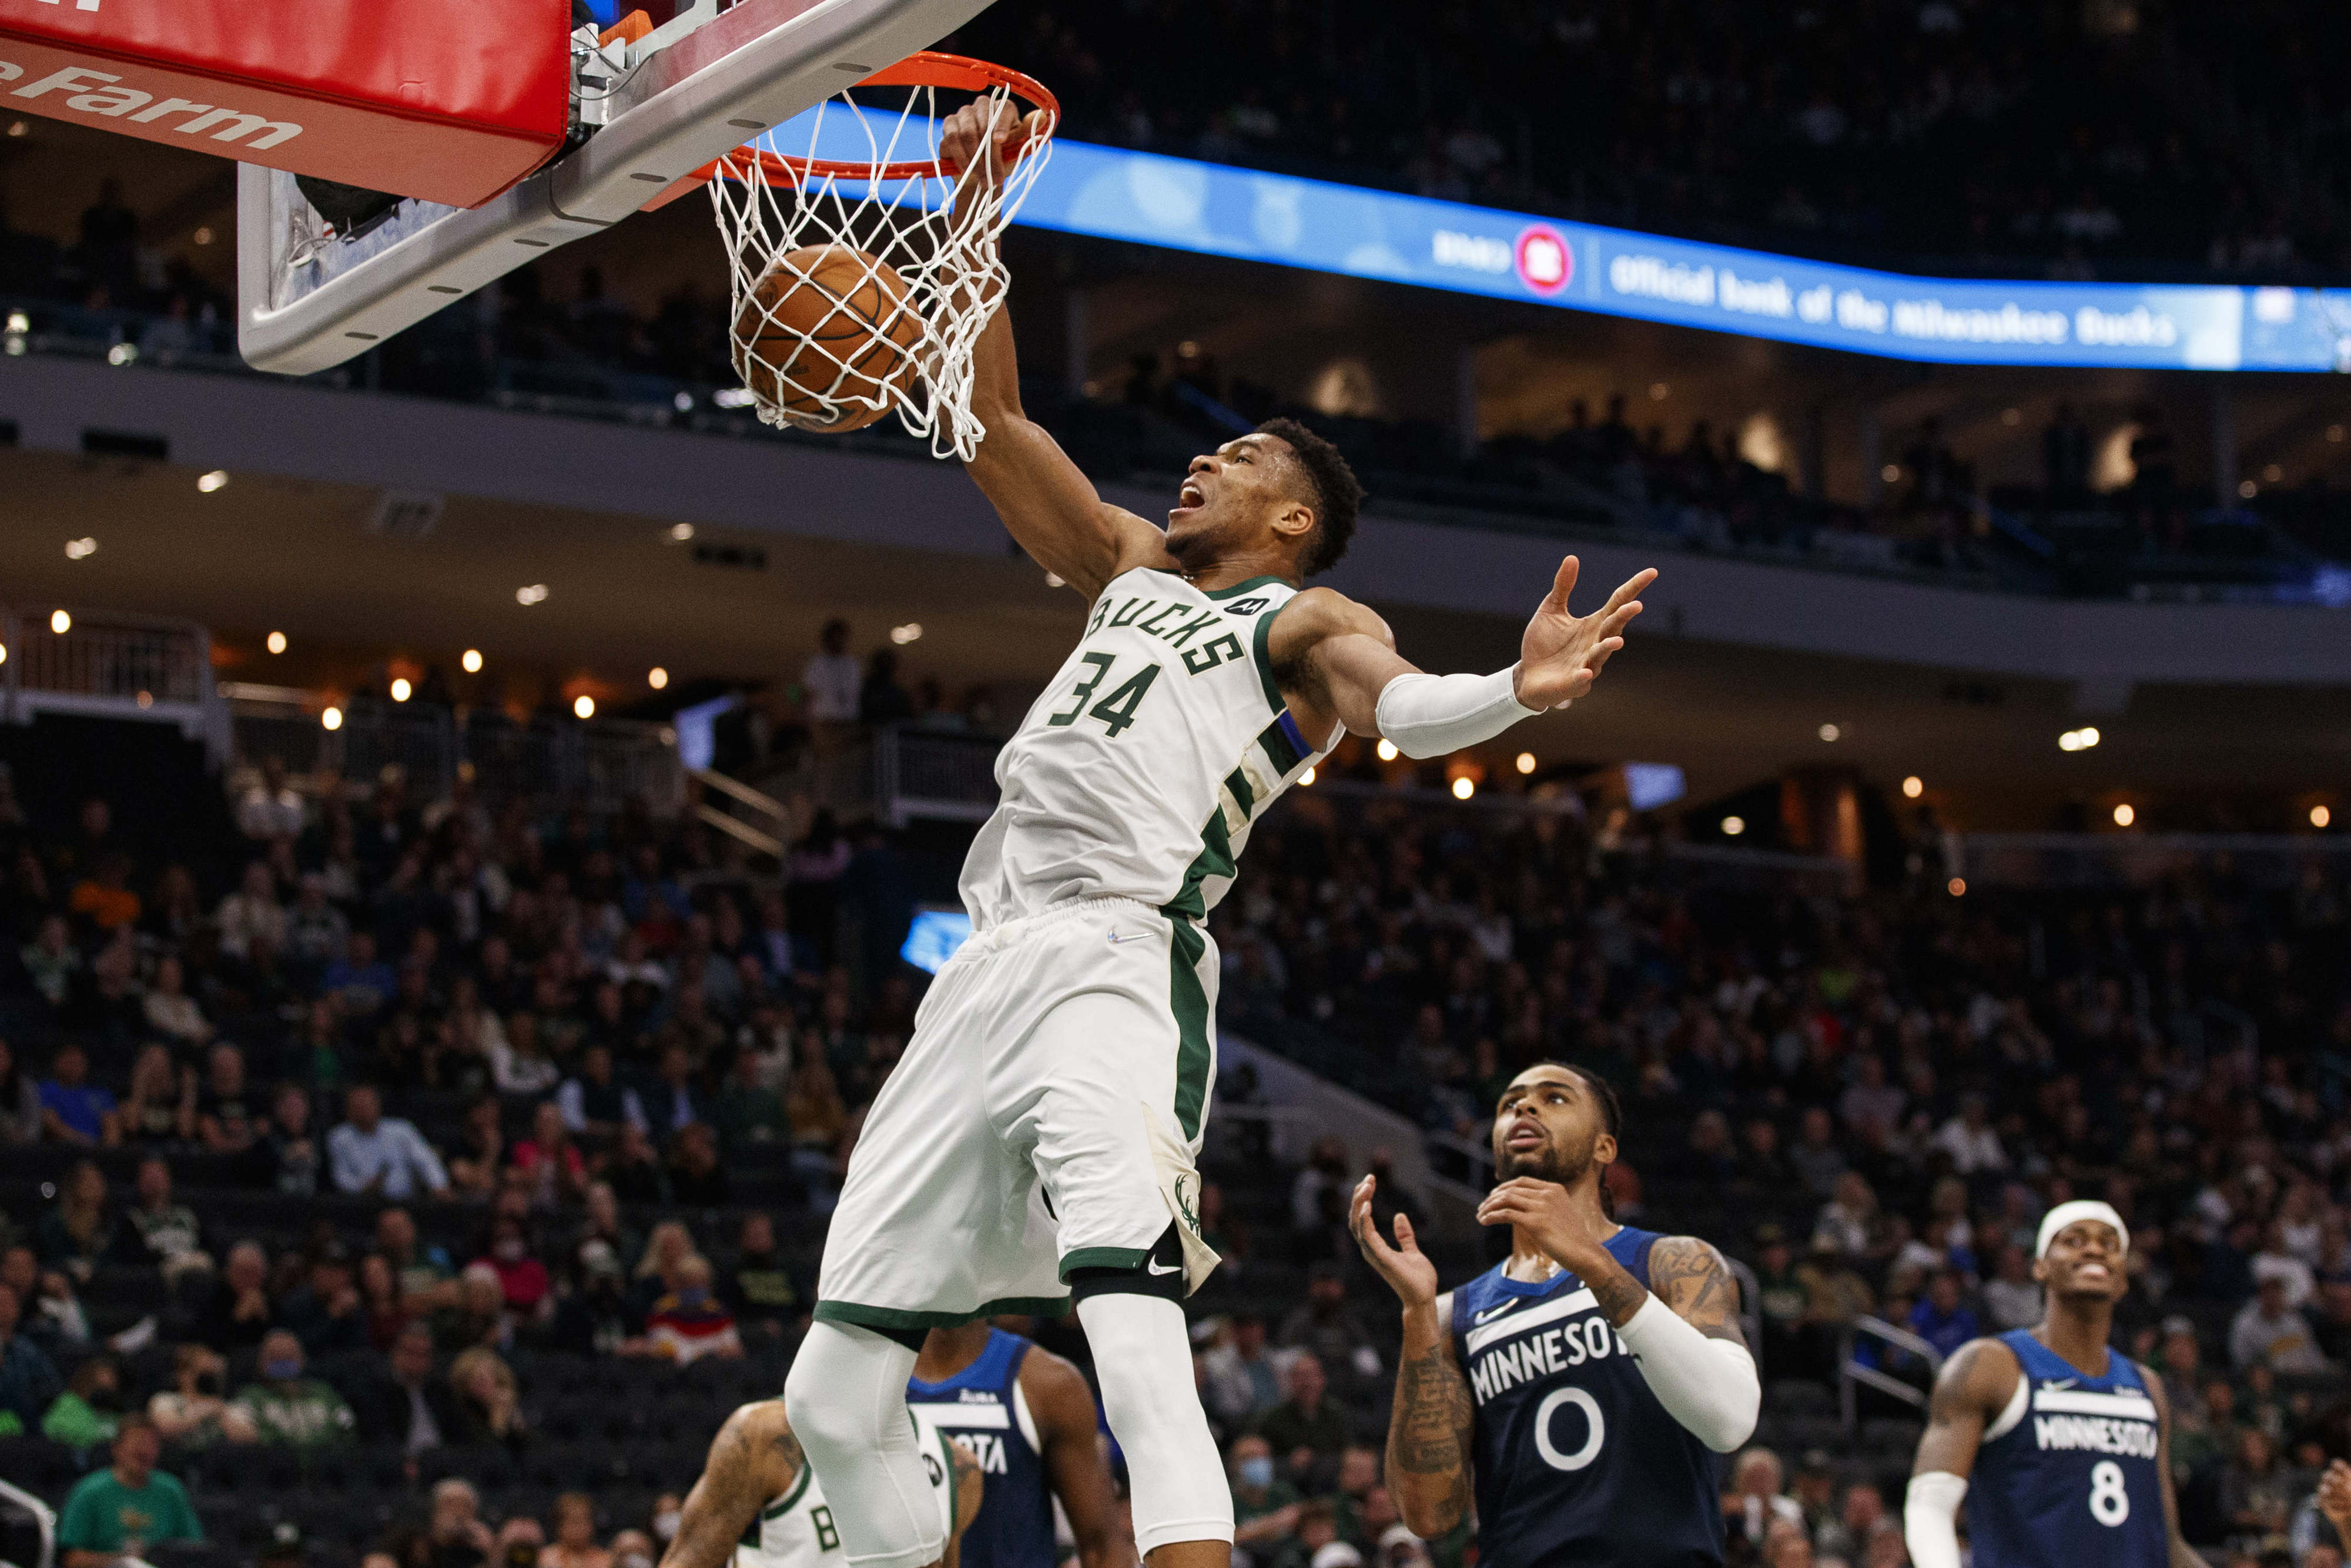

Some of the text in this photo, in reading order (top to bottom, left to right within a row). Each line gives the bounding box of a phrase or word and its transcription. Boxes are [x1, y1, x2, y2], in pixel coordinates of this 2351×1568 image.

[10, 66, 303, 150] Farm
[1718, 269, 1793, 320] bank
[1836, 288, 1888, 334] the
[1087, 597, 1247, 676] BUCKS
[1048, 651, 1162, 739] 34
[2089, 1460, 2129, 1527] 8
